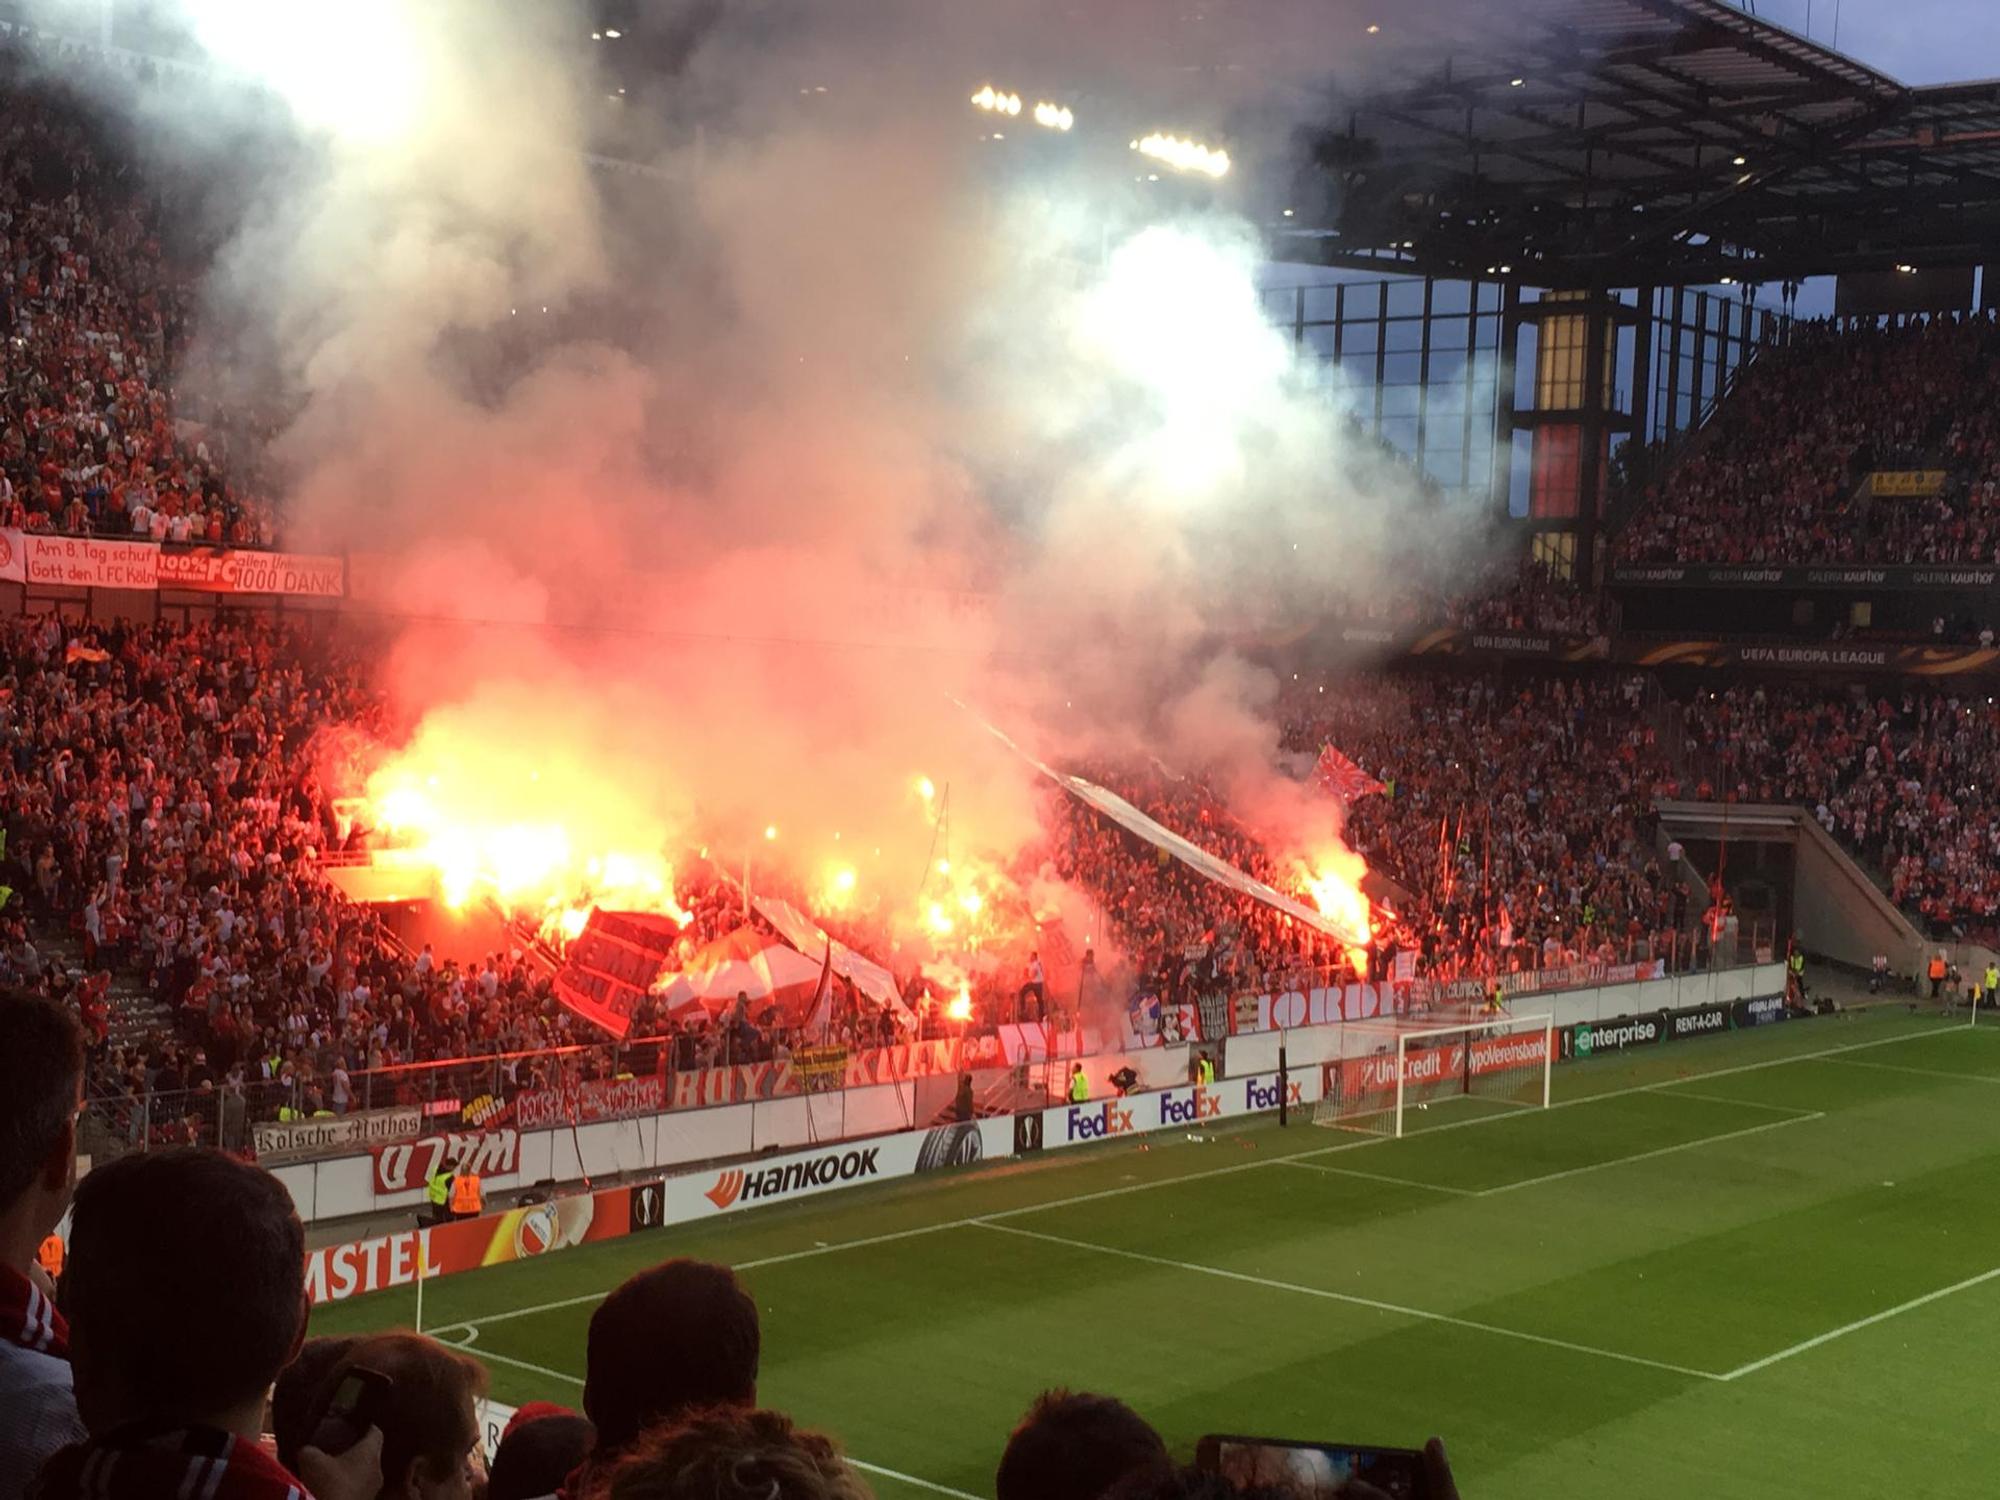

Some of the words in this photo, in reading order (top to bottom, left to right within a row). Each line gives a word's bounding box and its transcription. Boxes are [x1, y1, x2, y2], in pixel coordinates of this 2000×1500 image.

[36, 539, 62, 556] Am
[66, 541, 79, 559] 8.
[82, 542, 107, 565] Tag
[113, 544, 152, 563] schuf
[159, 555, 207, 574] 100%
[236, 553, 268, 570] allen
[31, 560, 63, 579] Gott
[68, 563, 92, 583] den
[107, 566, 123, 583] FC
[207, 558, 236, 583] FC
[235, 567, 277, 590] 1000
[284, 571, 341, 593] DANK
[1741, 647, 1775, 662] UEFA
[1778, 648, 1829, 663] EUROPA
[1832, 650, 1886, 665] LEAGUE
[1576, 1021, 1655, 1049] enterprise
[1675, 1012, 1723, 1034] RENT-A-CAR
[1468, 1036, 1547, 1074] ypoVereinsbank
[1246, 1074, 1302, 1110] Fedx
[1160, 1087, 1221, 1125] FedEx
[1068, 1099, 1133, 1141] FedEx
[303, 1229, 441, 1304] MSTEL
